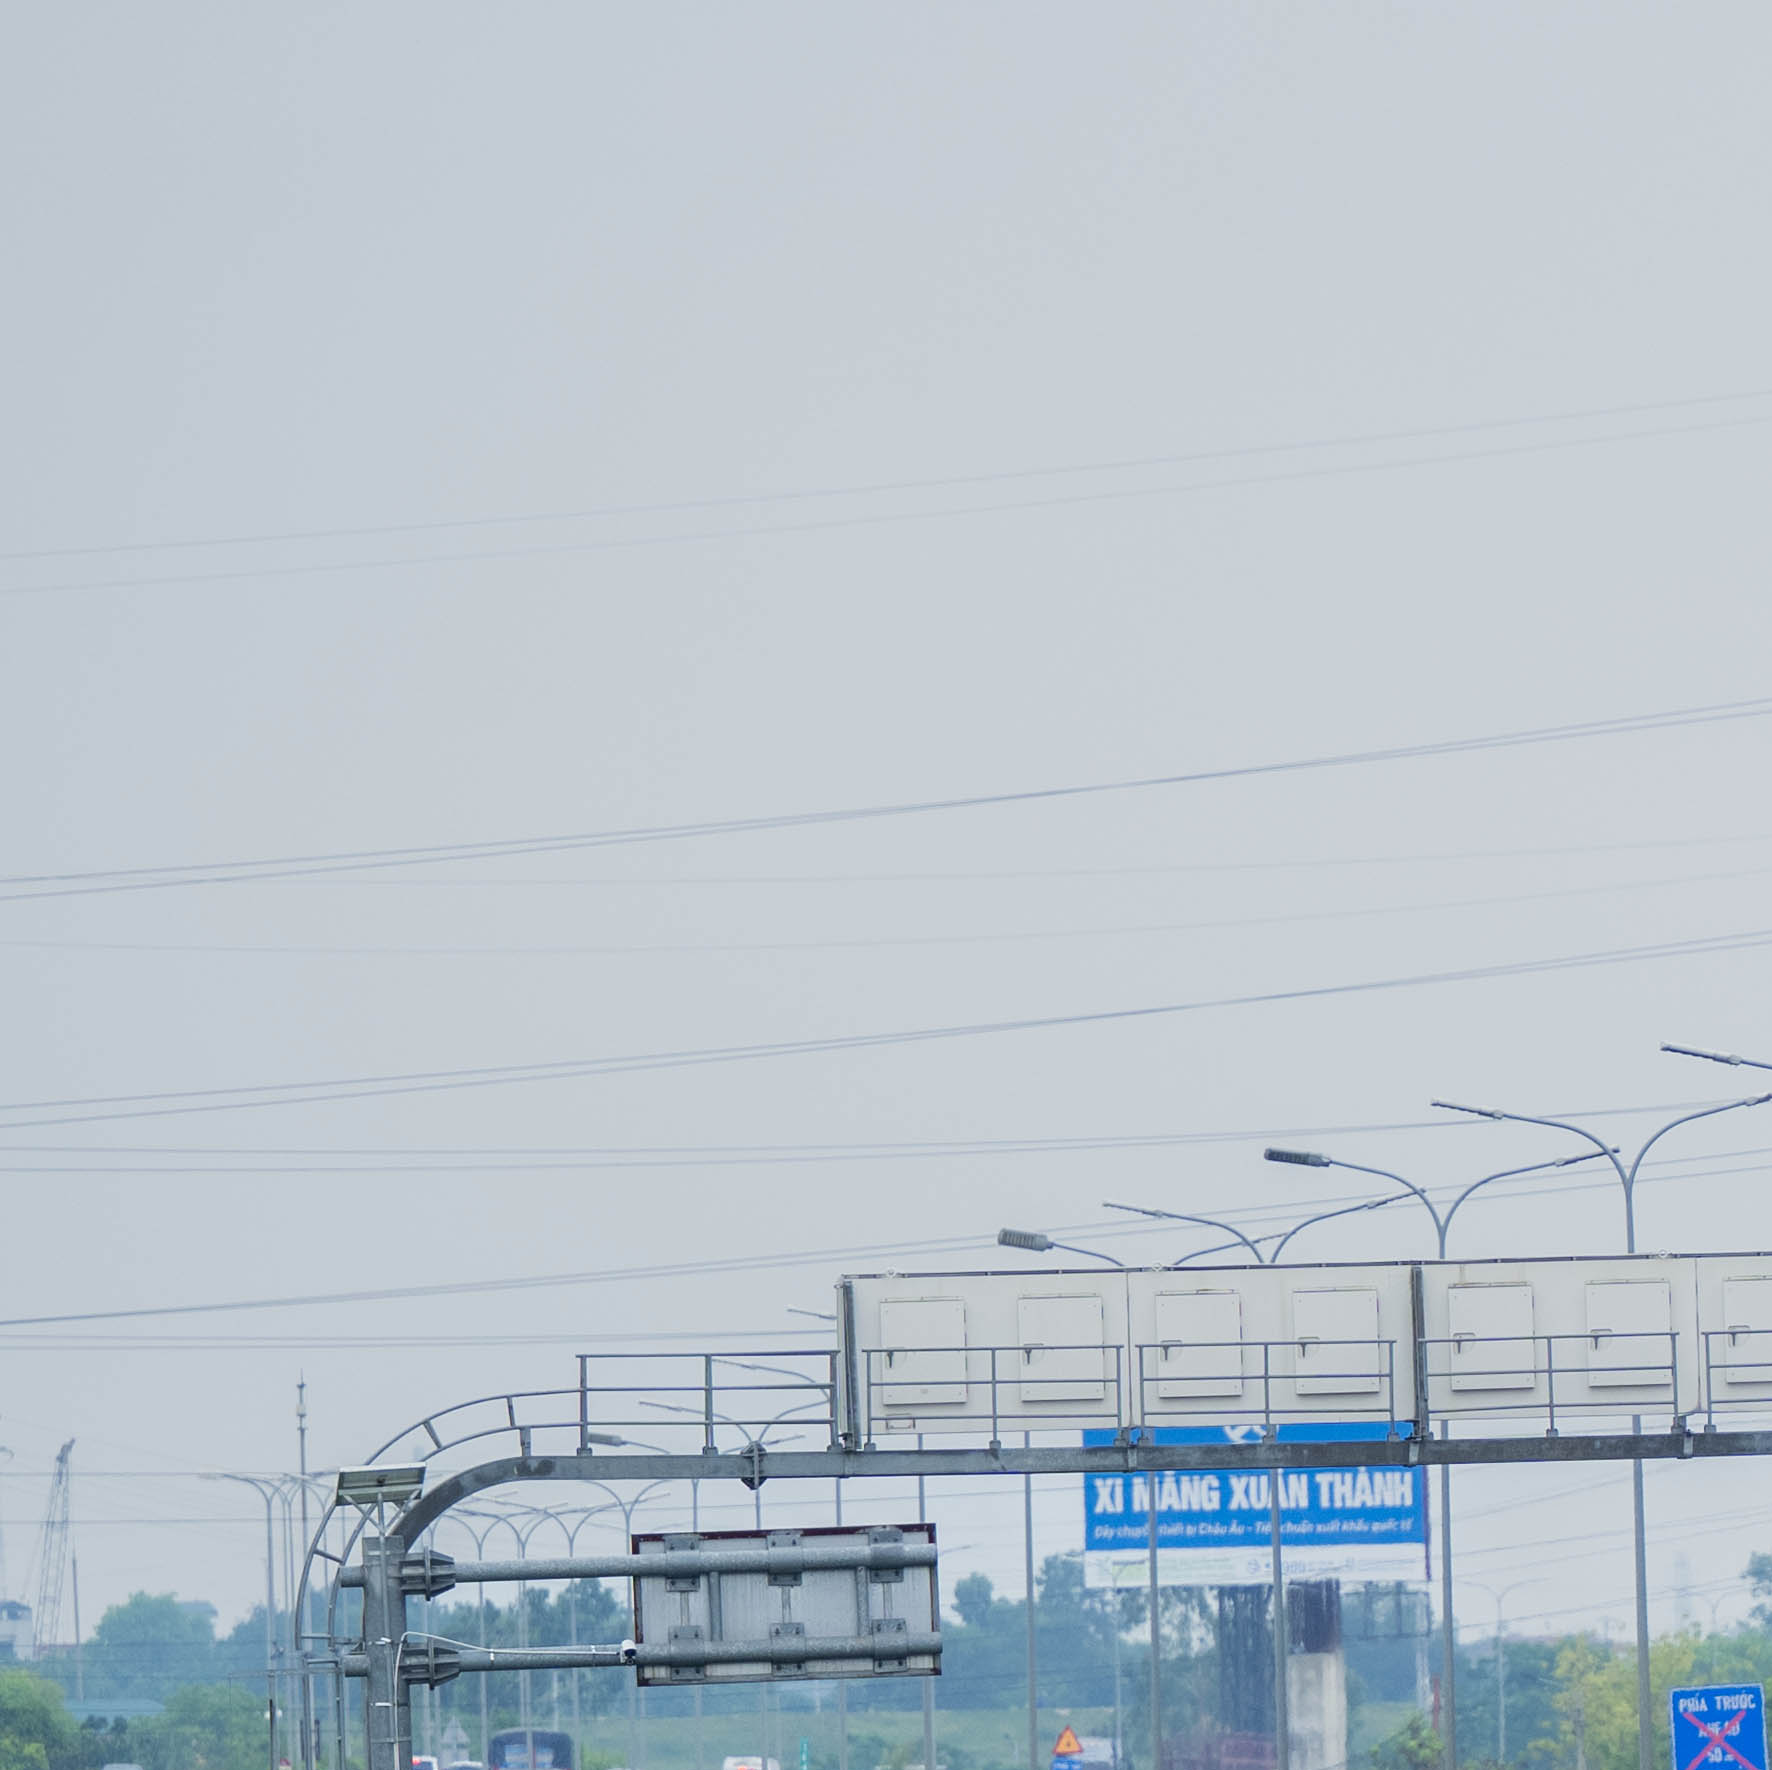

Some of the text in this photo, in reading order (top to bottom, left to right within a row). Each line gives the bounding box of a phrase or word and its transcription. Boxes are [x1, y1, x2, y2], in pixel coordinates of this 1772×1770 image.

[1094, 1477, 1124, 1514] XI
[1132, 1471, 1221, 1512] MĂNG
[1316, 1467, 1413, 1509] THÀNH
[1679, 1691, 1708, 1713] PHÍA
